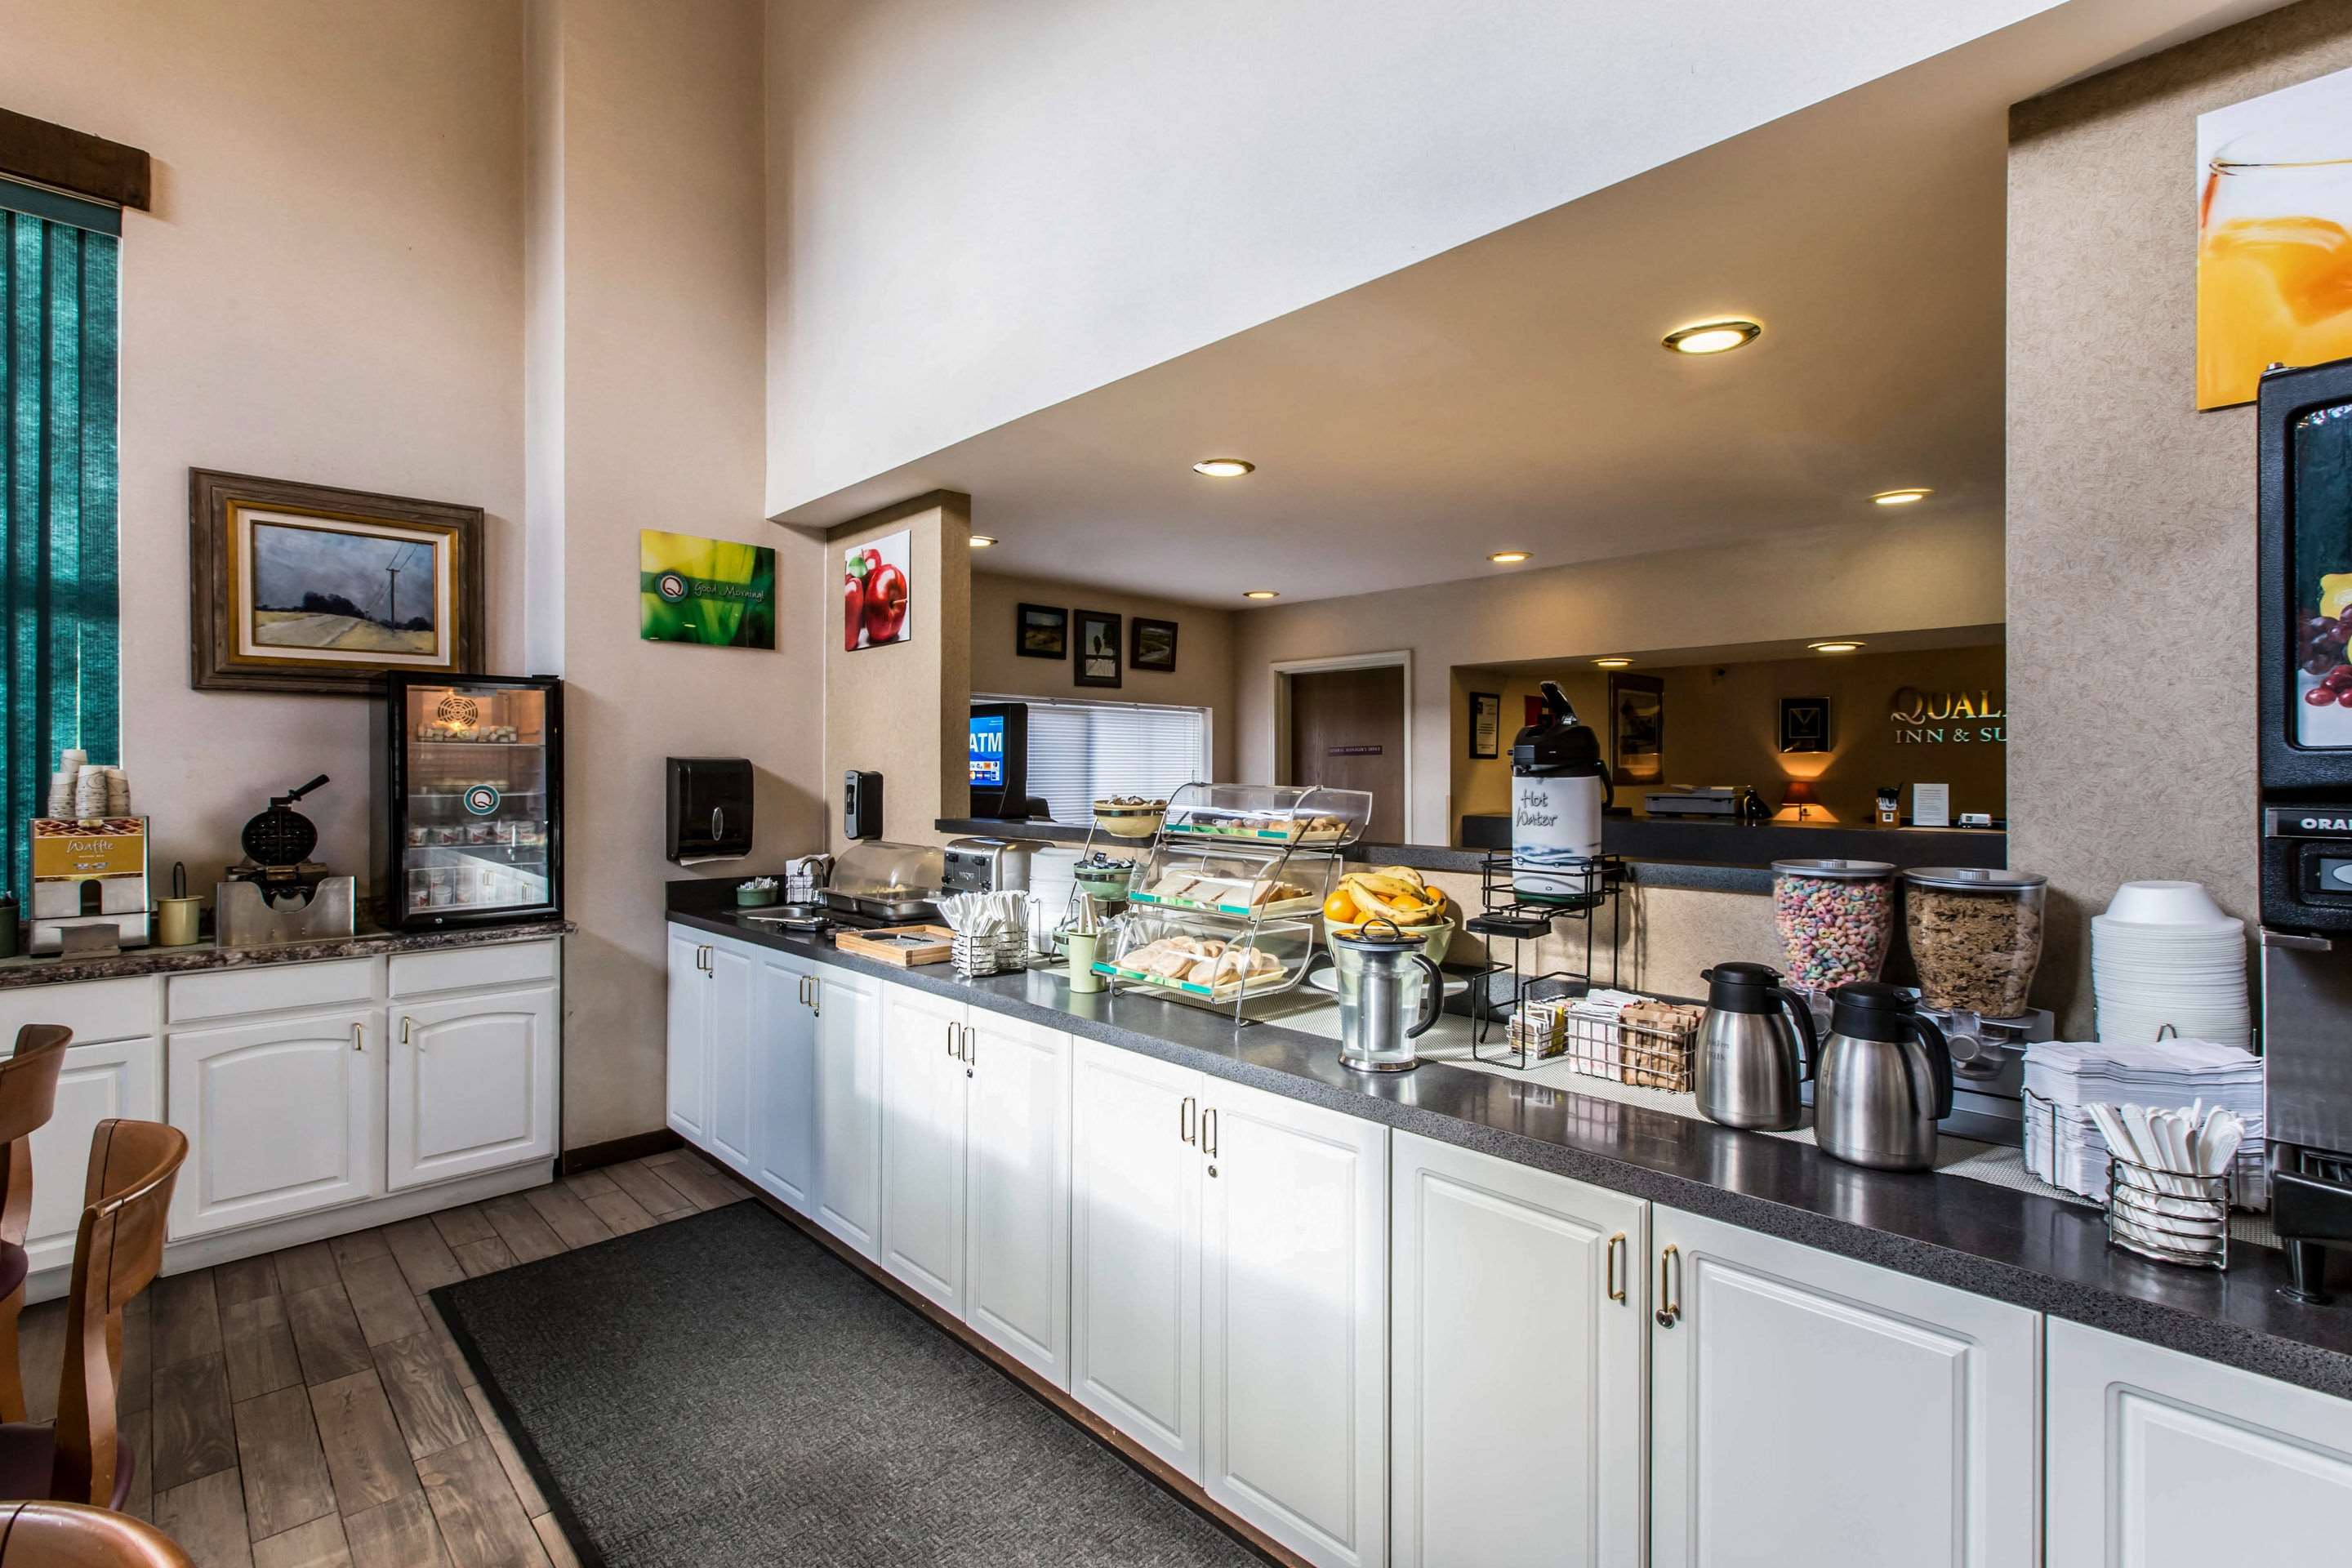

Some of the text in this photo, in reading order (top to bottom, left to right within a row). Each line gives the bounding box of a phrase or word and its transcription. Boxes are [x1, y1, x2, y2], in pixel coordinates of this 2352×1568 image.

[693, 581, 765, 602] Good Morning!
[1891, 687, 2007, 725] QUAL
[969, 732, 1002, 752] ATM
[1895, 728, 1944, 743] INN
[1953, 728, 1971, 742] &
[1521, 788, 1548, 808] Hot
[1516, 807, 1558, 827] Water
[2301, 817, 2352, 830] ORA
[66, 839, 114, 853] Waffle
